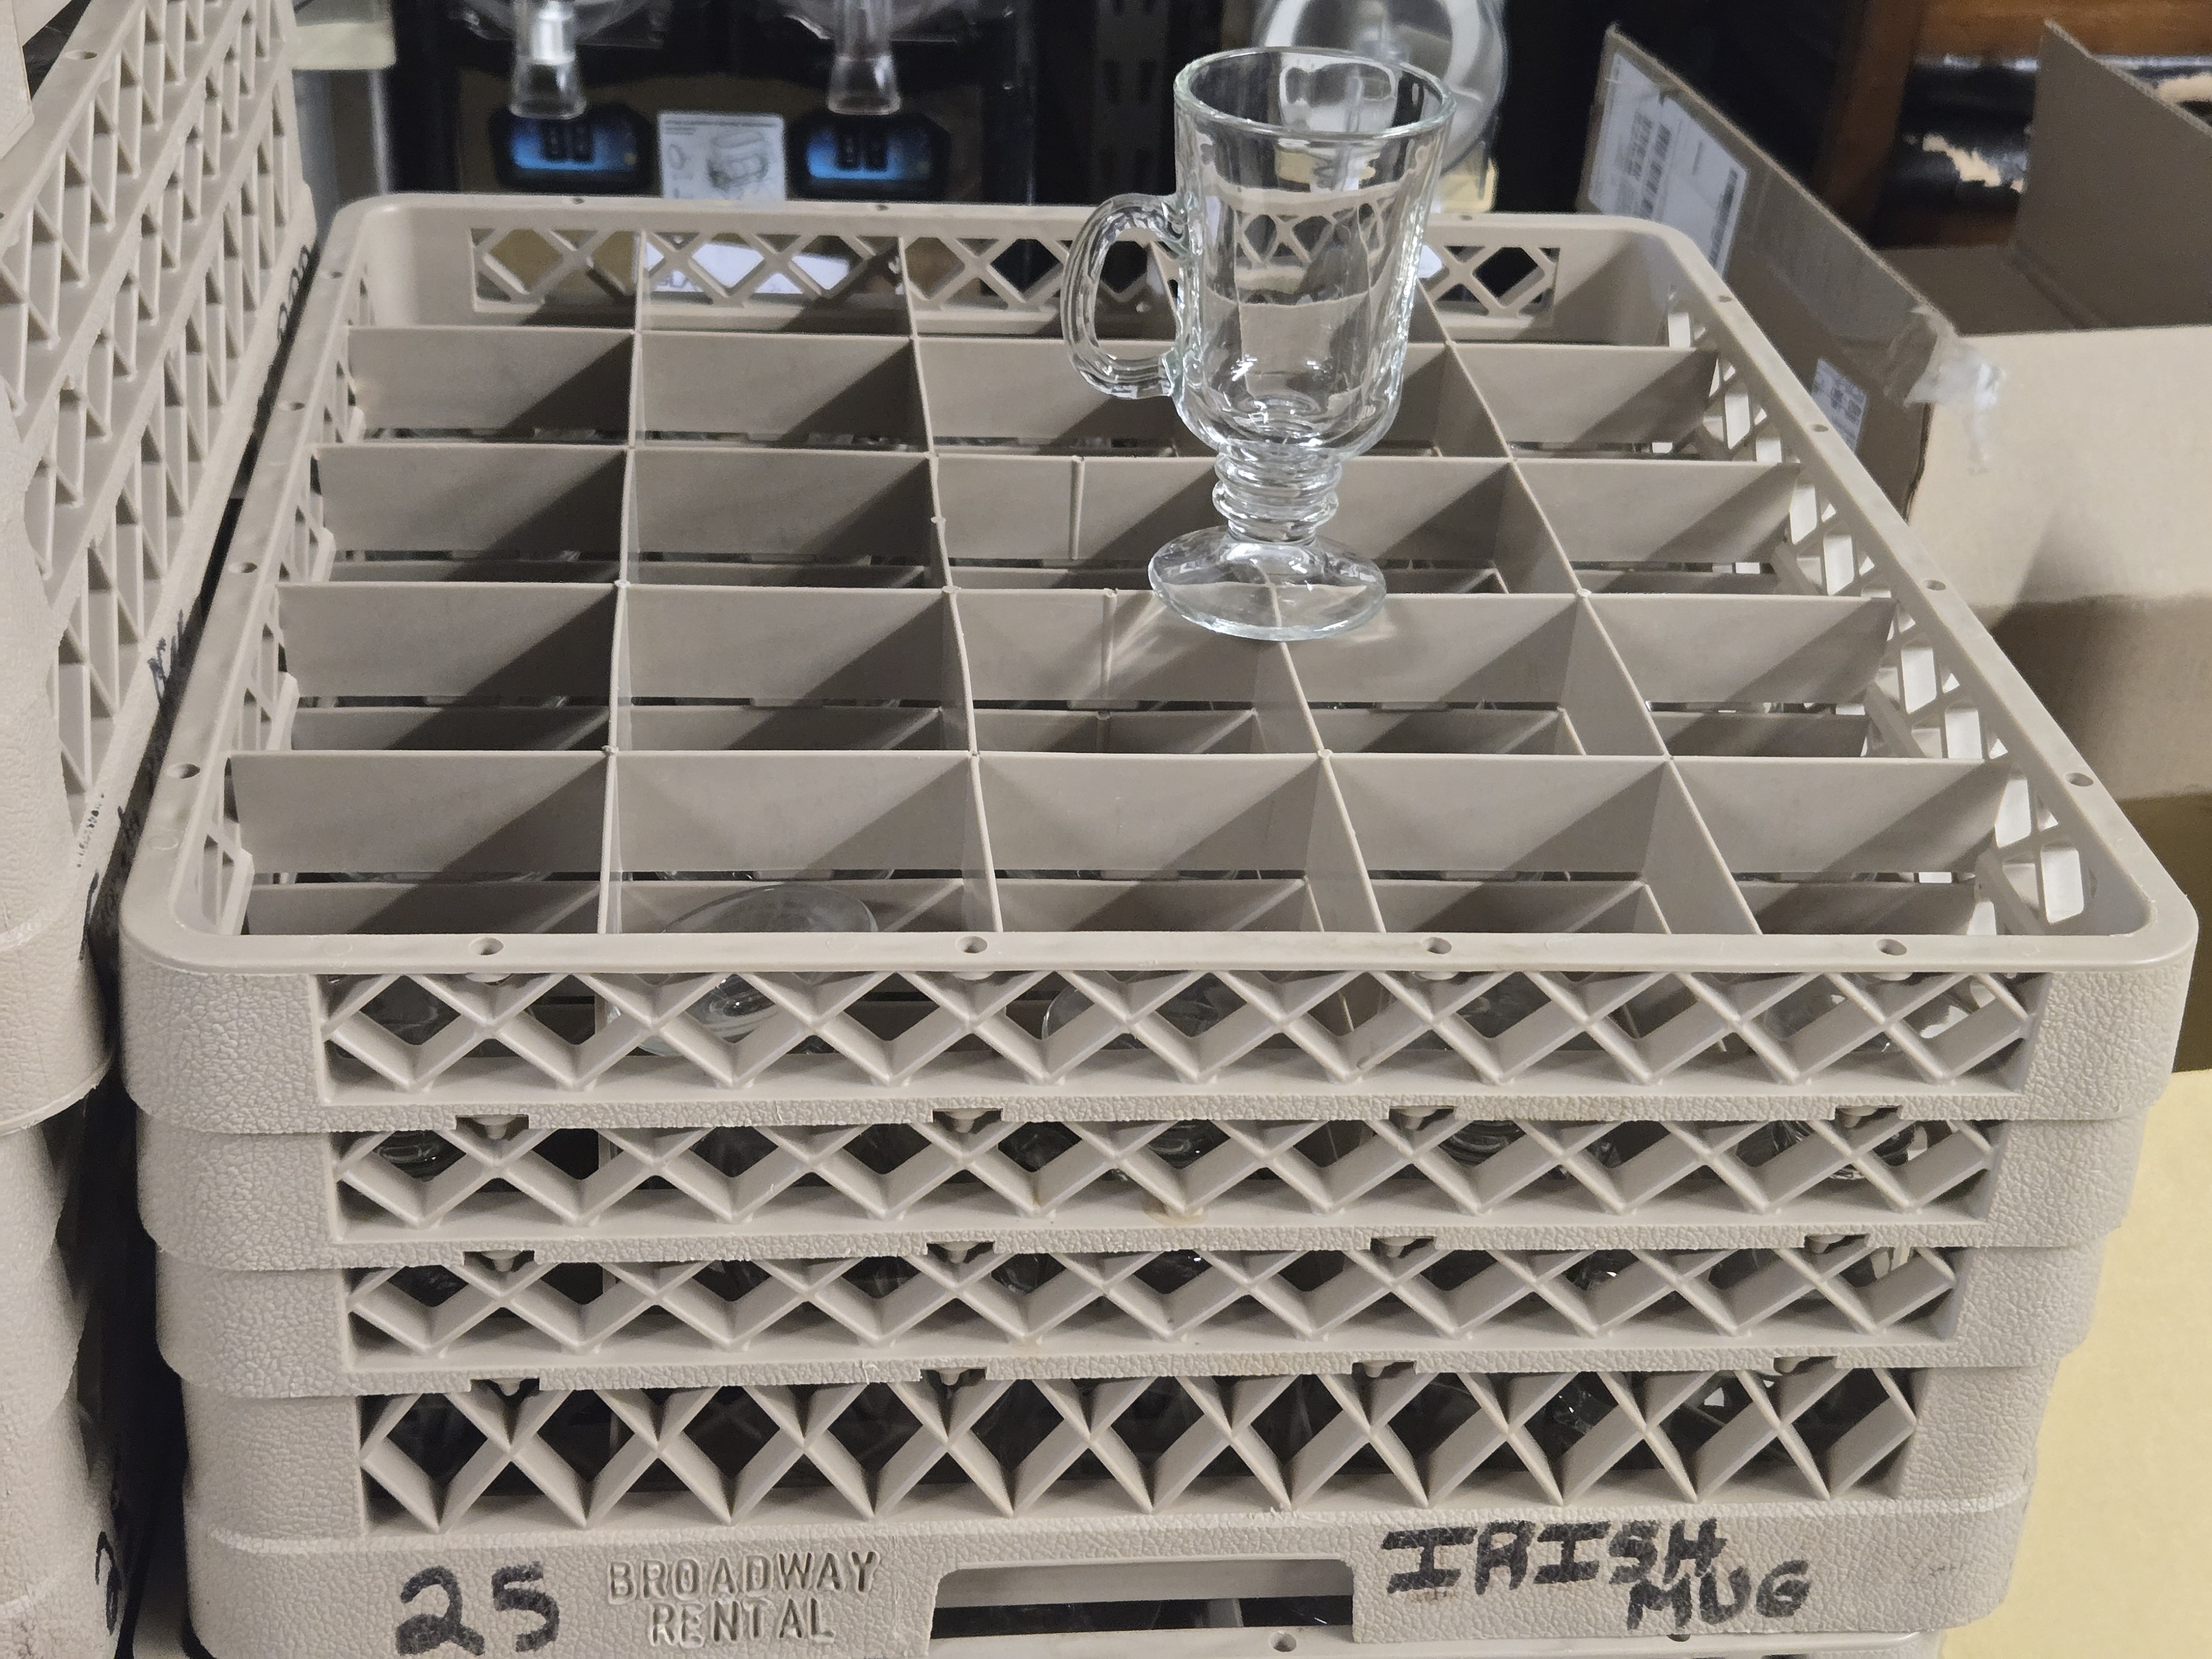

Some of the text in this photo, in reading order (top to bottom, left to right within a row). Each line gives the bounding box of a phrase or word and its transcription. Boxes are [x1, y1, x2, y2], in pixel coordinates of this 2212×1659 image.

[607, 1550, 881, 1603] BROADWAY
[1380, 1517, 1728, 1595] IRISH
[395, 1561, 561, 1655] 25
[648, 1596, 836, 1648] RENTAL
[1626, 1559, 1812, 1630] MUG
